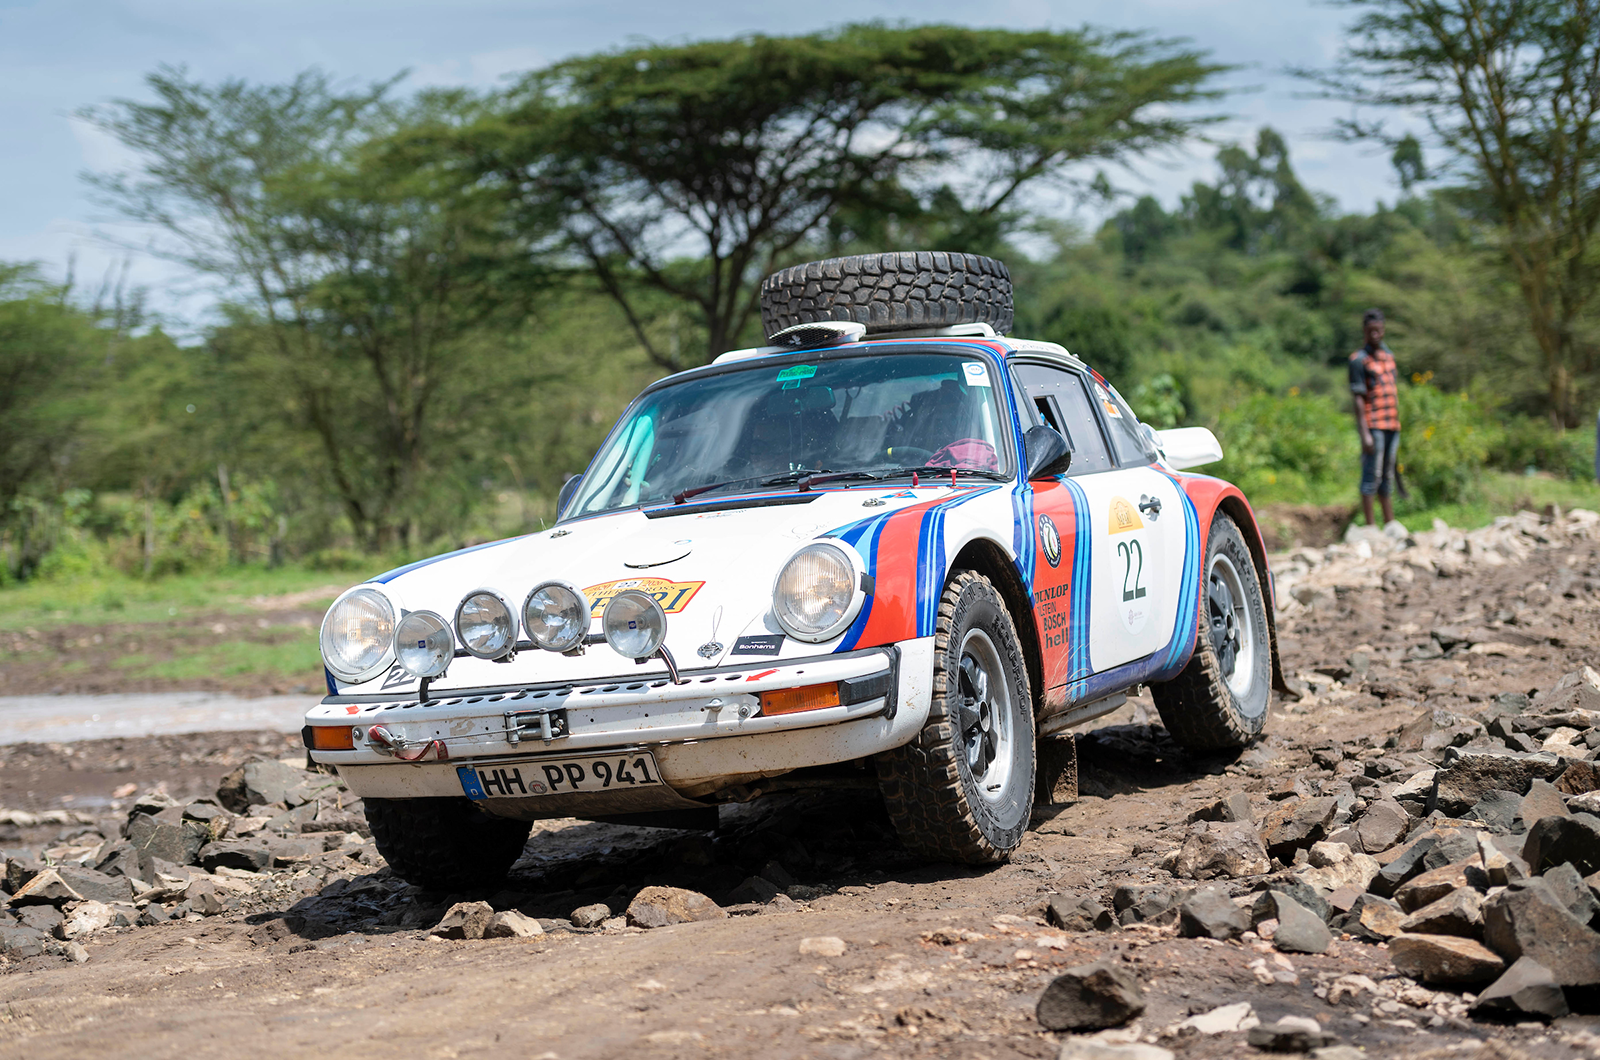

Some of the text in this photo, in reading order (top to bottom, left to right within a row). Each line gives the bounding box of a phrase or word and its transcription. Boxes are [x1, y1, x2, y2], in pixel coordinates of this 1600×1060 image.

[1117, 538, 1146, 602] 22
[1034, 583, 1069, 604] DUNLOP
[1043, 611, 1067, 632] BOSCH
[1043, 627, 1069, 649] hell
[478, 758, 658, 796] HH PP 941
